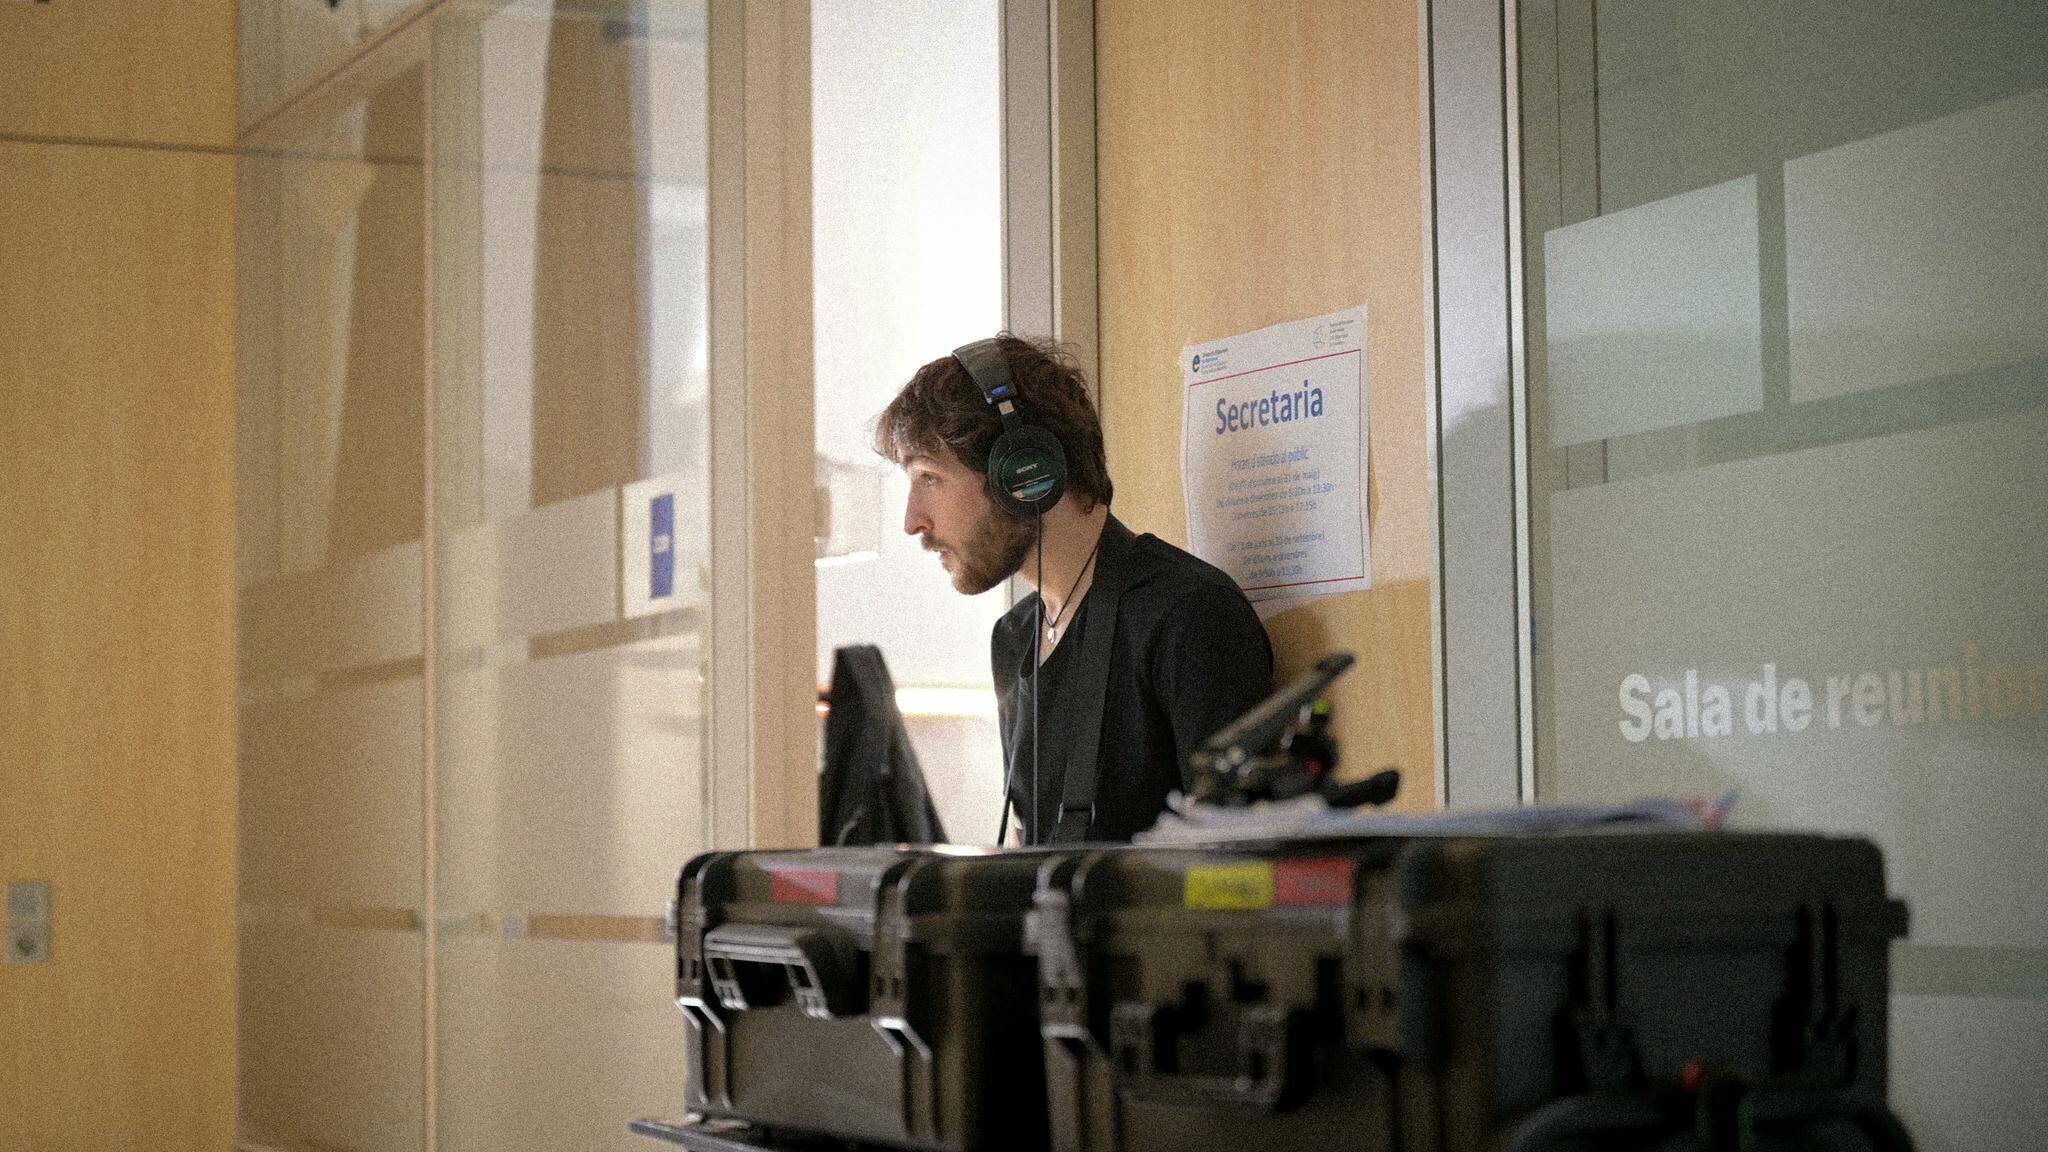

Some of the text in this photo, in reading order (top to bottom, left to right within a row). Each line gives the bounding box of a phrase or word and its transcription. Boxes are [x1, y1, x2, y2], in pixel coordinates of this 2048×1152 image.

[1216, 379, 1324, 435] Secretaria
[1015, 463, 1039, 474] SONY
[1618, 669, 1733, 743] Sala
[1744, 662, 1814, 736] de
